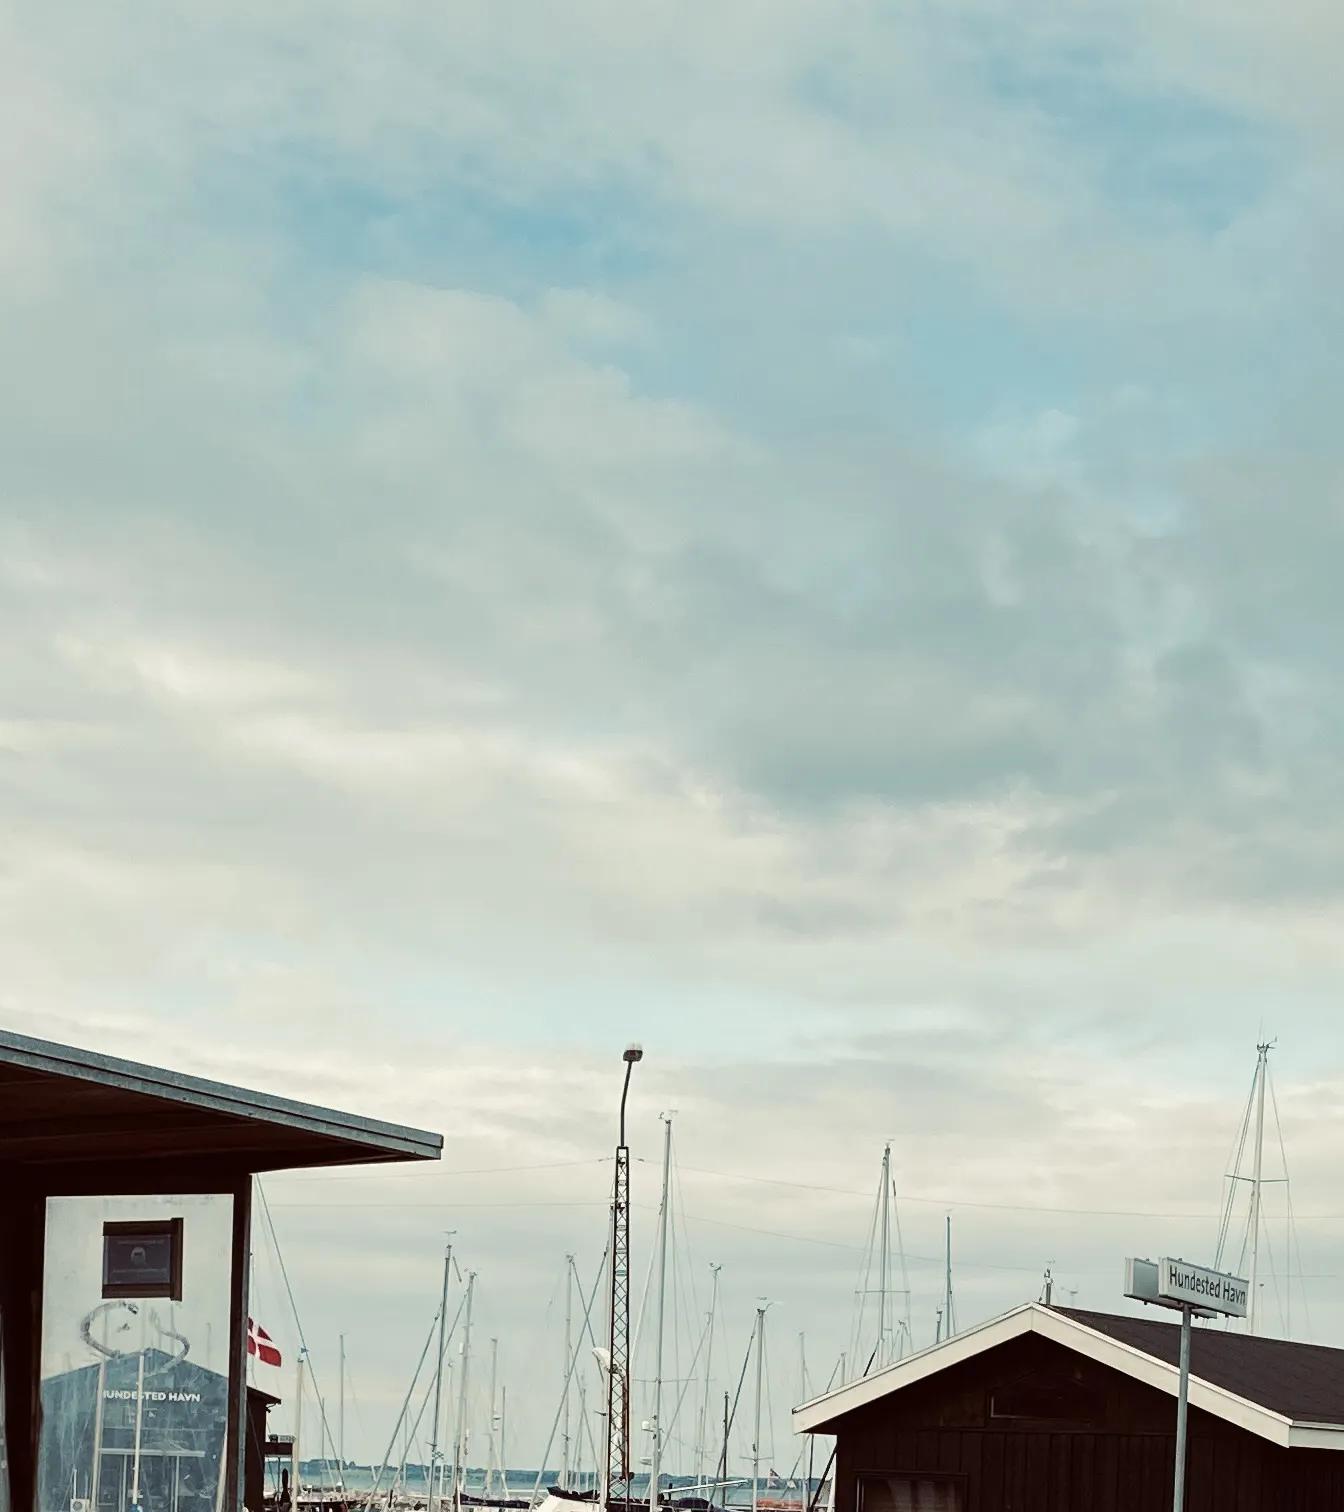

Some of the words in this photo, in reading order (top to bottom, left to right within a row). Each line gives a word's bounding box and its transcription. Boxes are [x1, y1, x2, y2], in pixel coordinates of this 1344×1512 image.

[1169, 1265, 1220, 1298] Hundested
[1223, 1281, 1246, 1305] Havn
[103, 1389, 166, 1401] UNDETED
[169, 1392, 201, 1403] HAVN
